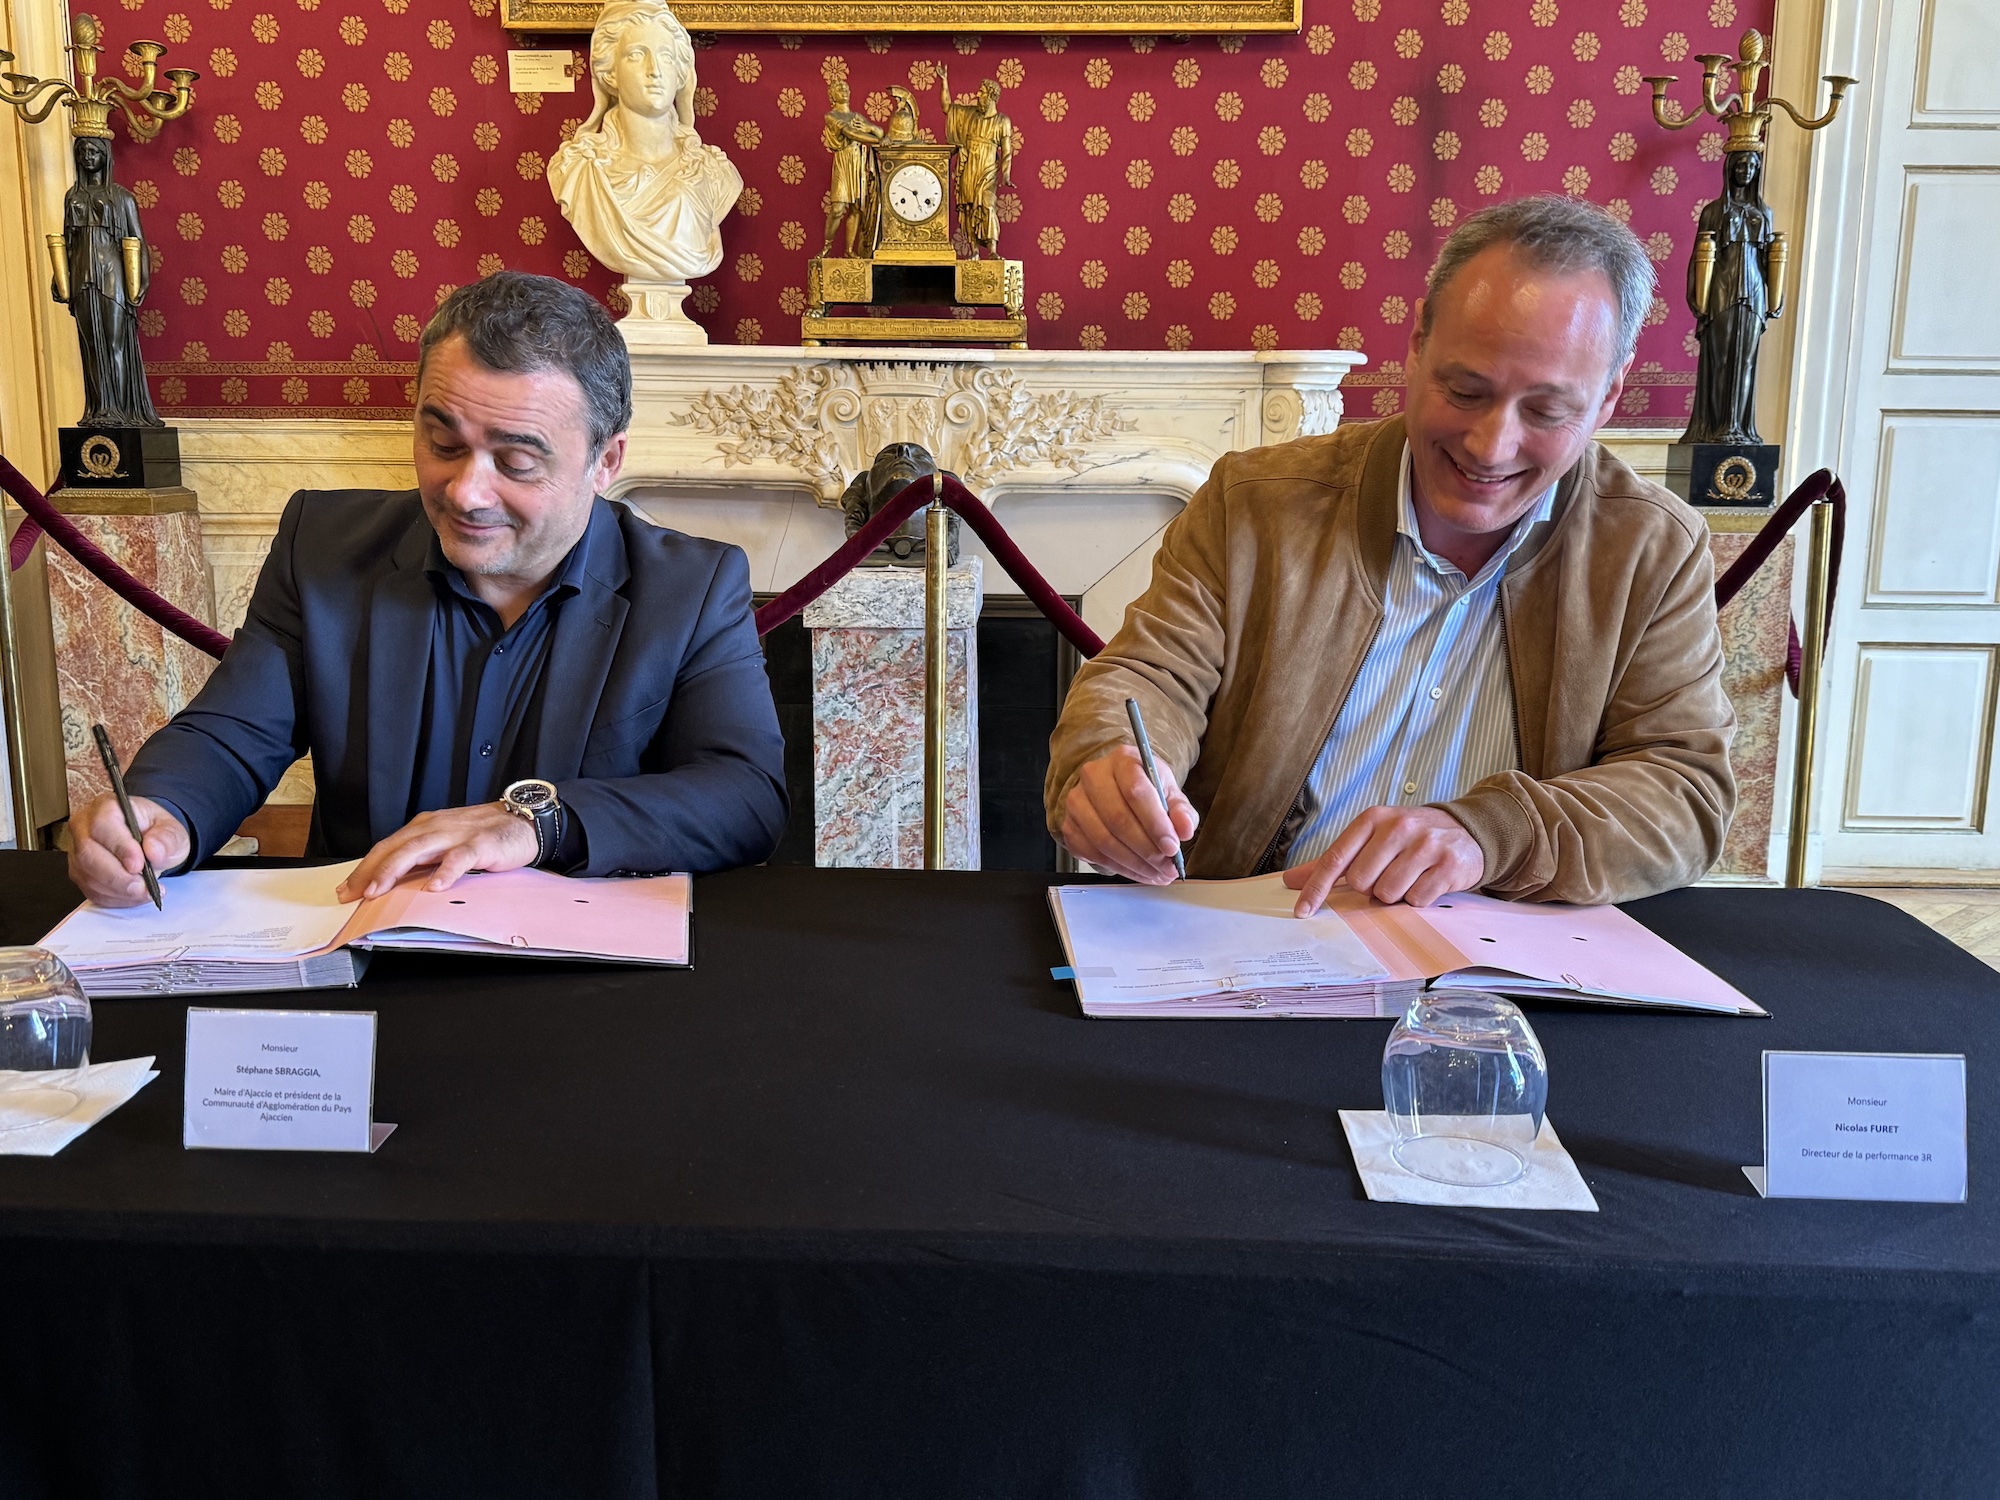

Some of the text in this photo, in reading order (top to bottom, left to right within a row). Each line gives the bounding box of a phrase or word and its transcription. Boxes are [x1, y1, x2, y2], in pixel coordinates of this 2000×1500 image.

[261, 1043, 299, 1053] Monsieur
[236, 1065, 321, 1078] Stéphane SBRAGGIA,
[214, 1087, 237, 1097] Maire
[274, 1091, 283, 1099] et
[284, 1091, 321, 1103] président
[322, 1092, 333, 1101] de
[334, 1092, 342, 1102] la
[202, 1098, 254, 1109] Communauté
[321, 1103, 332, 1112] du
[333, 1104, 352, 1114] Pays
[1847, 1096, 1888, 1107] Monsieur
[260, 1112, 293, 1123] Ajaccien
[1835, 1123, 1899, 1134] Nicolas FURET
[1801, 1148, 1933, 1162] Directeur de la performance 3R
